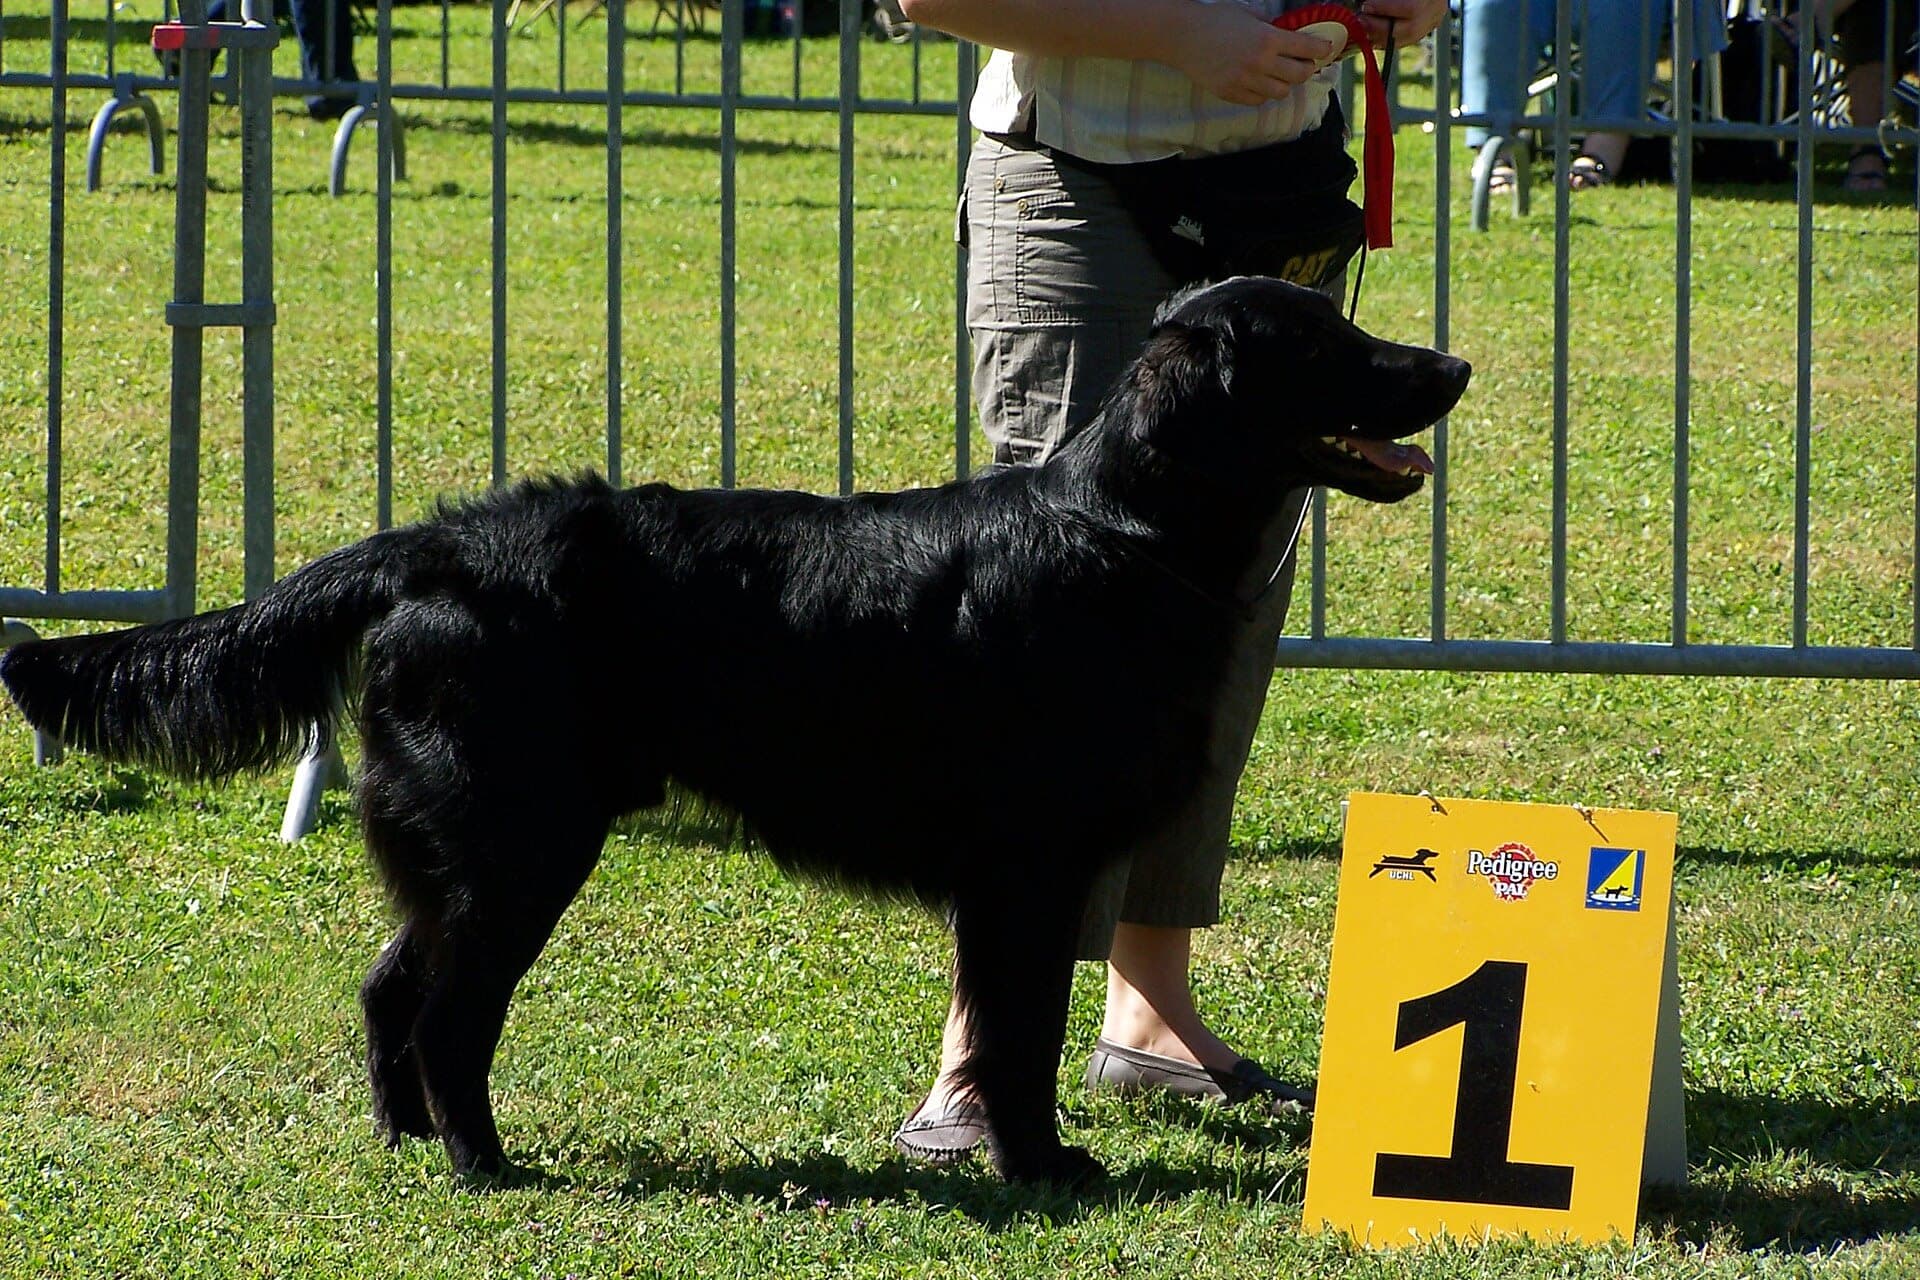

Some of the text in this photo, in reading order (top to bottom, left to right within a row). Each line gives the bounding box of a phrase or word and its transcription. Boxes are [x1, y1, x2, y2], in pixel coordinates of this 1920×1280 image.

[1281, 247, 1338, 285] CAT
[1389, 870, 1415, 880] UCHL
[1467, 849, 1559, 881] Pedigree
[1495, 881, 1528, 897] PAL
[1372, 960, 1575, 1211] 1
